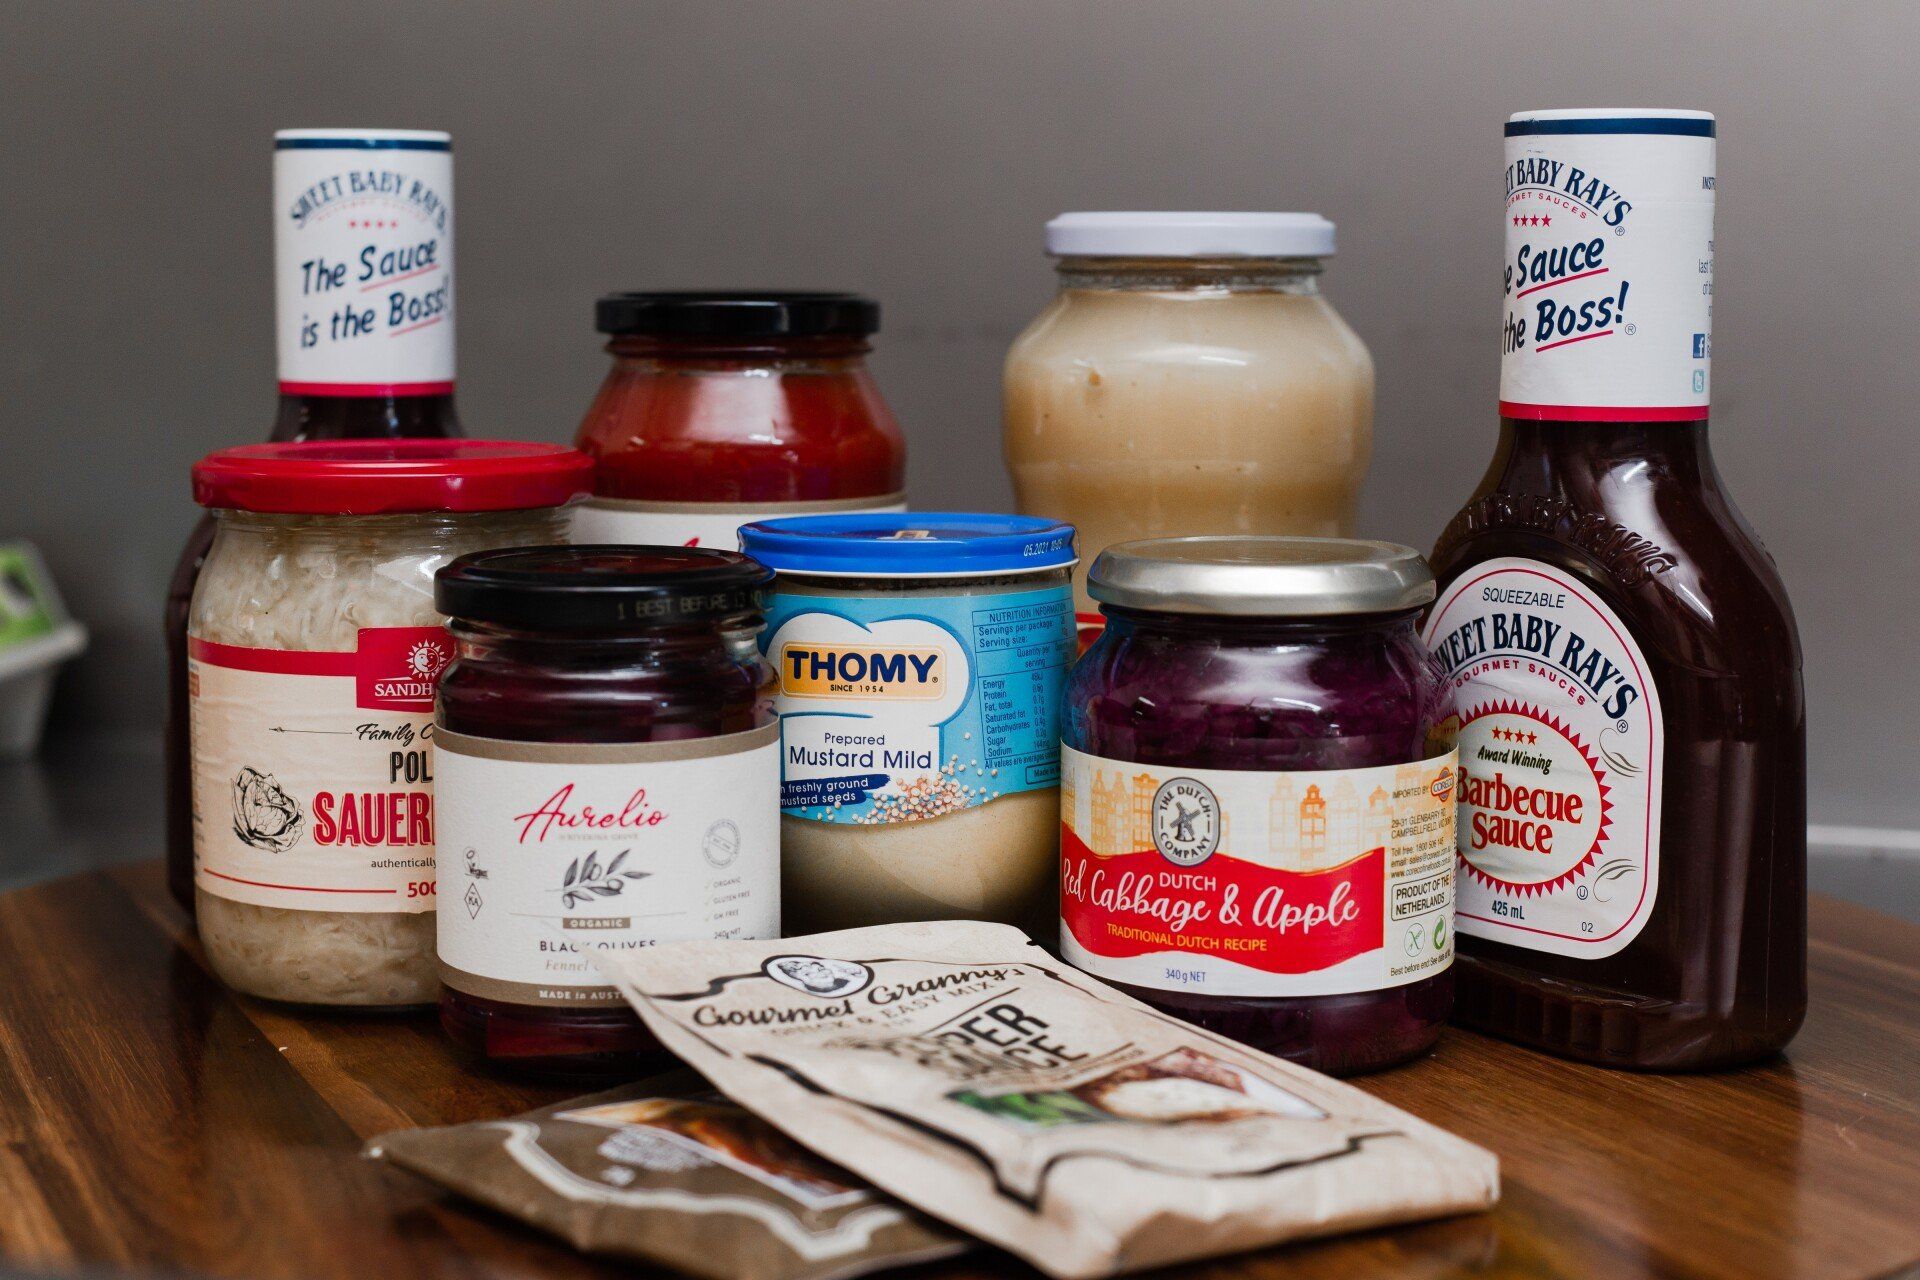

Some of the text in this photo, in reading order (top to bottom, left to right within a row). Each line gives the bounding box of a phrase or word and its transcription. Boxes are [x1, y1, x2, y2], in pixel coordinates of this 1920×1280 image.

[291, 176, 342, 229] SWEET
[349, 171, 405, 194] BABY
[1517, 158, 1564, 187] BABY
[1563, 166, 1633, 227] RAY'S
[1539, 193, 1587, 219] SAUCES
[302, 239, 438, 294] The Sauce
[1516, 237, 1605, 289] Sauce
[301, 314, 319, 348] is
[332, 304, 375, 340] the
[1503, 280, 1630, 355] the Boss!
[636, 598, 672, 618] BEST
[680, 594, 728, 613] BEFORE
[1482, 587, 1565, 608] SQUEEZABLE
[989, 609, 1030, 622] NUTRITION
[979, 625, 1013, 636] Servings
[1016, 624, 1026, 632] per
[980, 637, 1010, 647] Serving
[786, 651, 938, 683] THOMY
[1492, 613, 1561, 658] BABY
[1559, 631, 1639, 720] RAY'S
[374, 683, 433, 697] SANDH
[830, 684, 884, 693] SINCE 1954
[983, 680, 1005, 690] Energy
[1456, 660, 1586, 706] GOURMET SAUCES
[984, 690, 1007, 700] Protein
[986, 711, 1016, 723] Saturated
[987, 721, 1030, 734] Carbohydrates
[356, 722, 415, 747] Family
[824, 732, 886, 748] Prepared
[987, 736, 1006, 746] Sugar
[790, 746, 931, 770] Mustard Mild
[988, 748, 1012, 757] Sodium
[1477, 743, 1552, 775] Award Winning
[390, 751, 433, 783] POL
[788, 783, 822, 793] freshly
[826, 778, 868, 792] ground
[1392, 787, 1421, 799] IMPORTED
[1458, 766, 1583, 824] Barbecue
[822, 792, 856, 803] seeds
[1160, 786, 1211, 813] THE DUTCH
[313, 791, 436, 847] SAUER
[514, 783, 670, 844] Aurelio
[1471, 811, 1553, 854] Sauce
[1161, 832, 1210, 858] COMPANY
[713, 877, 741, 888] ORGANIC
[1159, 872, 1216, 891] DUTCH
[1396, 874, 1450, 900] PRODUCT OF THE
[1063, 858, 1360, 935] Red Cabbage & Apple
[1396, 892, 1445, 915] NETHERLANDS
[1491, 900, 1525, 920] 425 mL
[570, 919, 623, 928] ORGANIC
[1581, 921, 1594, 932] 02
[539, 940, 590, 952] BLAC
[1107, 924, 1267, 951] TRADITIONAL DUTCH RECIPE
[545, 960, 588, 971] Fennel
[1190, 971, 1206, 983] NET
[1390, 966, 1403, 976] Best
[1404, 962, 1420, 973] before
[539, 990, 571, 999] MADE
[575, 990, 586, 999] in
[881, 995, 939, 1018] EASY
[948, 981, 996, 997] MIX
[693, 999, 855, 1028] Gourmet
